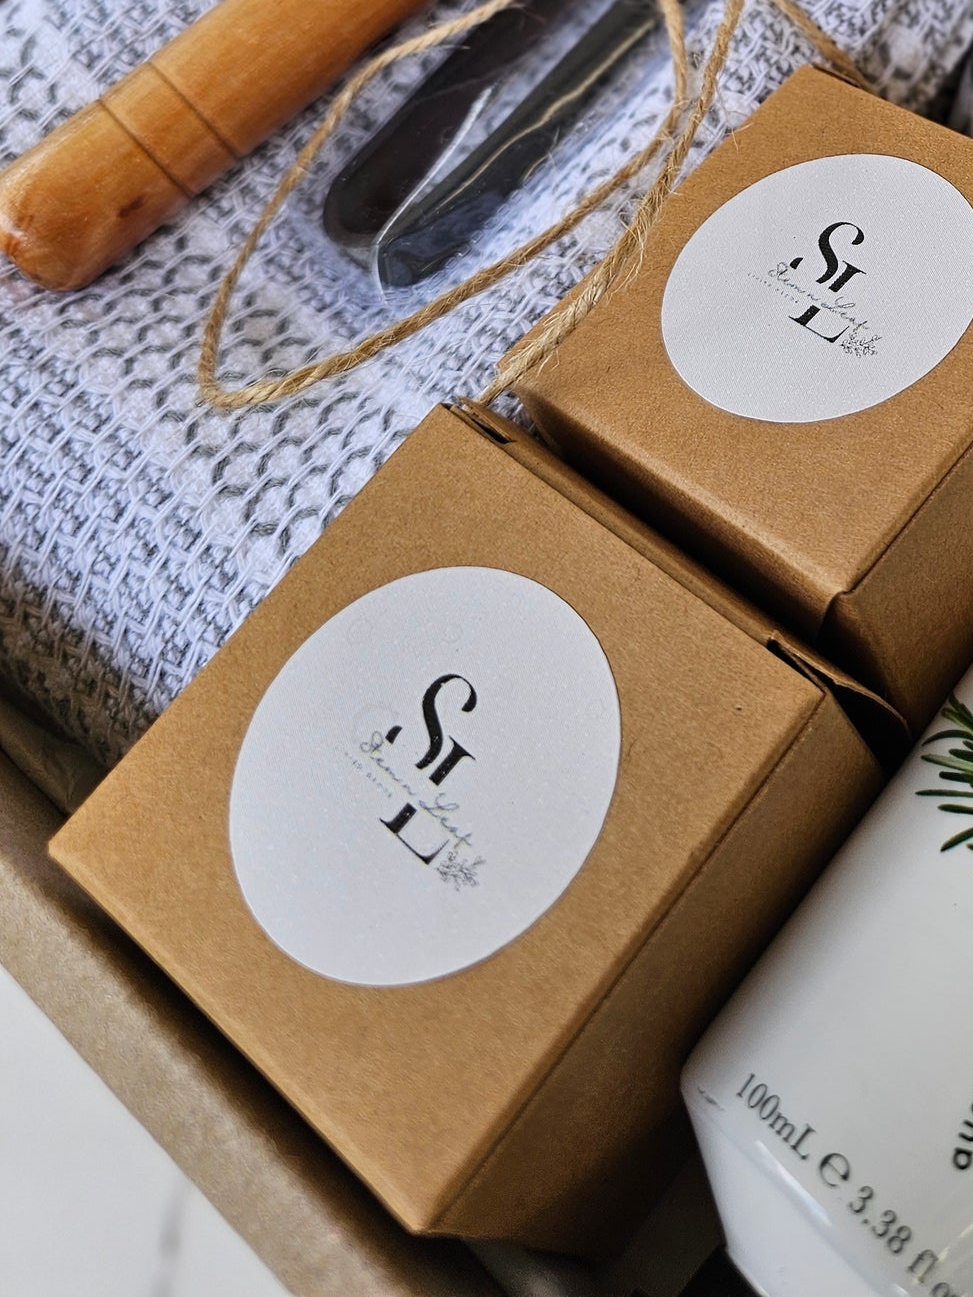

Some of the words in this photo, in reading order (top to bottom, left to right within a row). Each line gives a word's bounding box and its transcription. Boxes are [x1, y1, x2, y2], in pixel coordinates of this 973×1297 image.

[736, 1072, 816, 1161] 100mL
[849, 1185, 912, 1254] 3.38
[907, 1249, 939, 1284] fl
